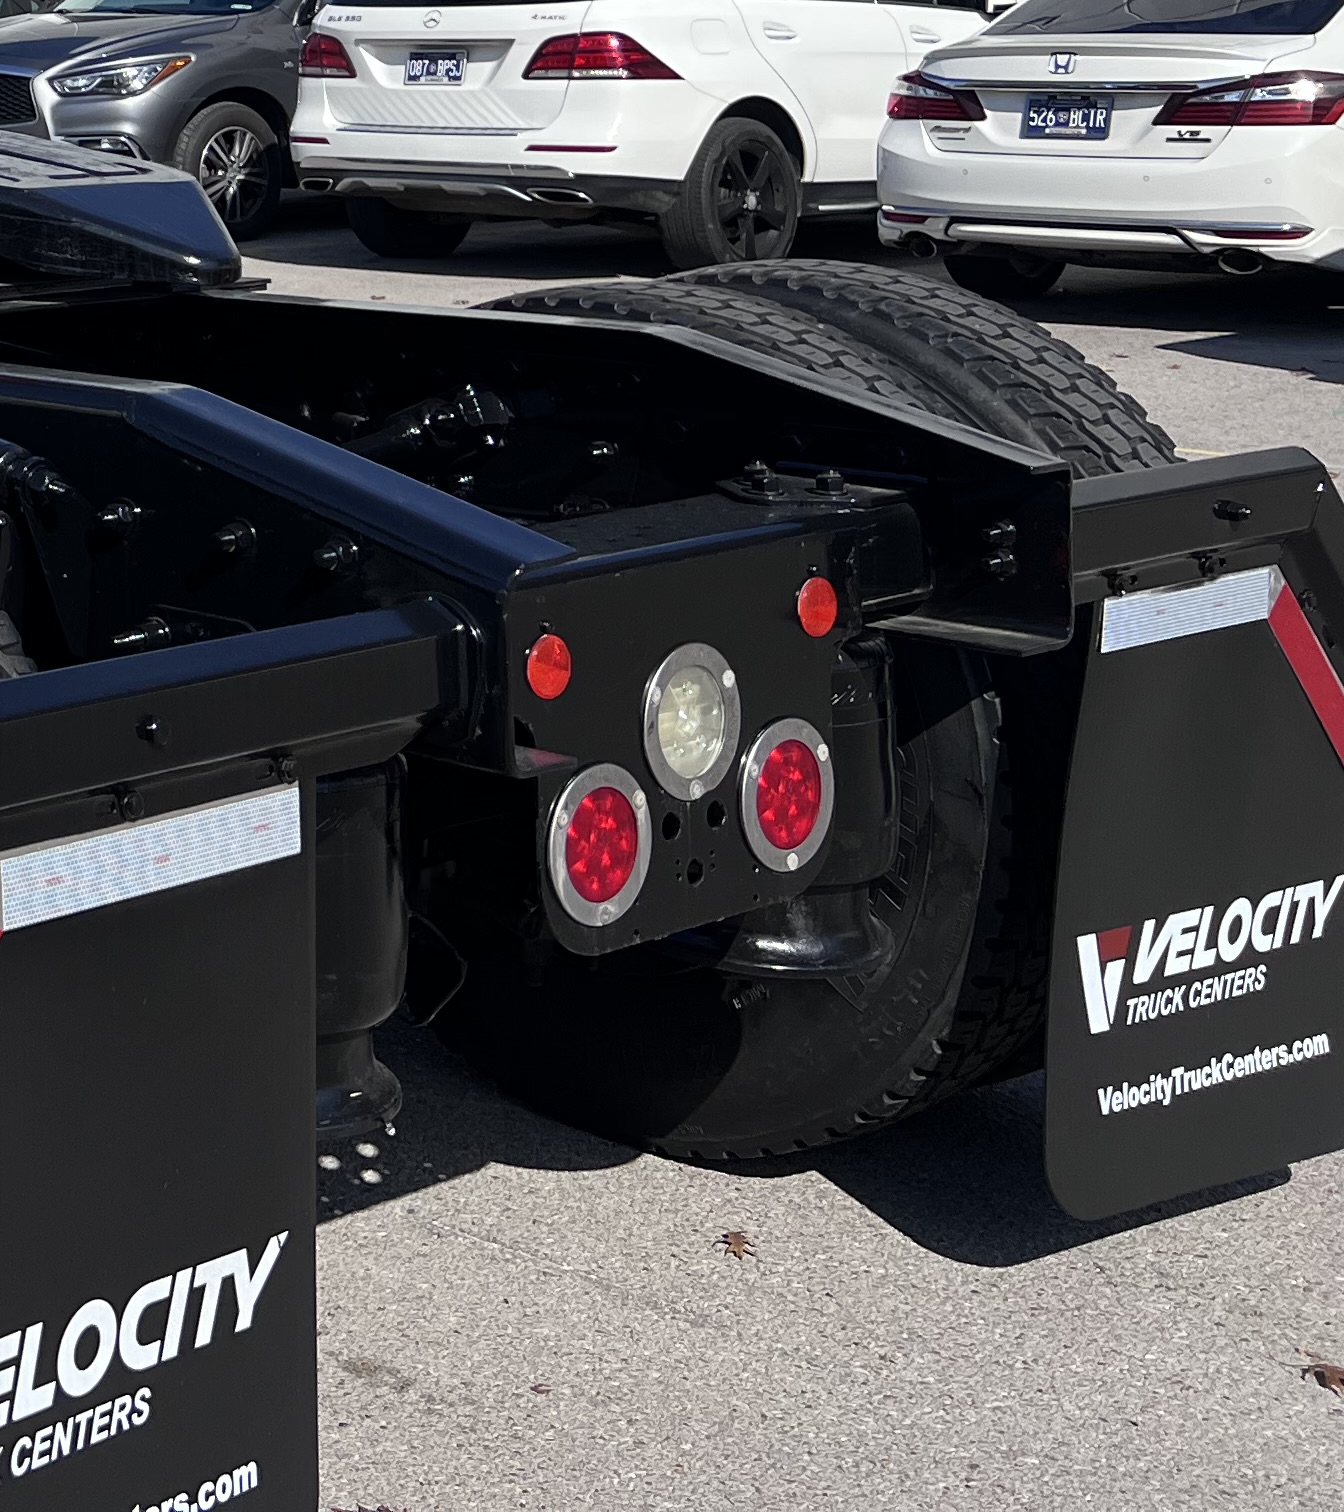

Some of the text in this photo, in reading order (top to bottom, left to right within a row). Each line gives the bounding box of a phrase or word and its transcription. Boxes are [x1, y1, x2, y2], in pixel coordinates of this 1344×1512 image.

[1028, 107, 1107, 128] 526 BCTR
[1132, 874, 1344, 985] VELOCITY
[1125, 963, 1268, 1026] TRUCK CENTERS
[1097, 1032, 1331, 1117] VelocityTruckCenters.com
[10, 1386, 153, 1478] CENTERS
